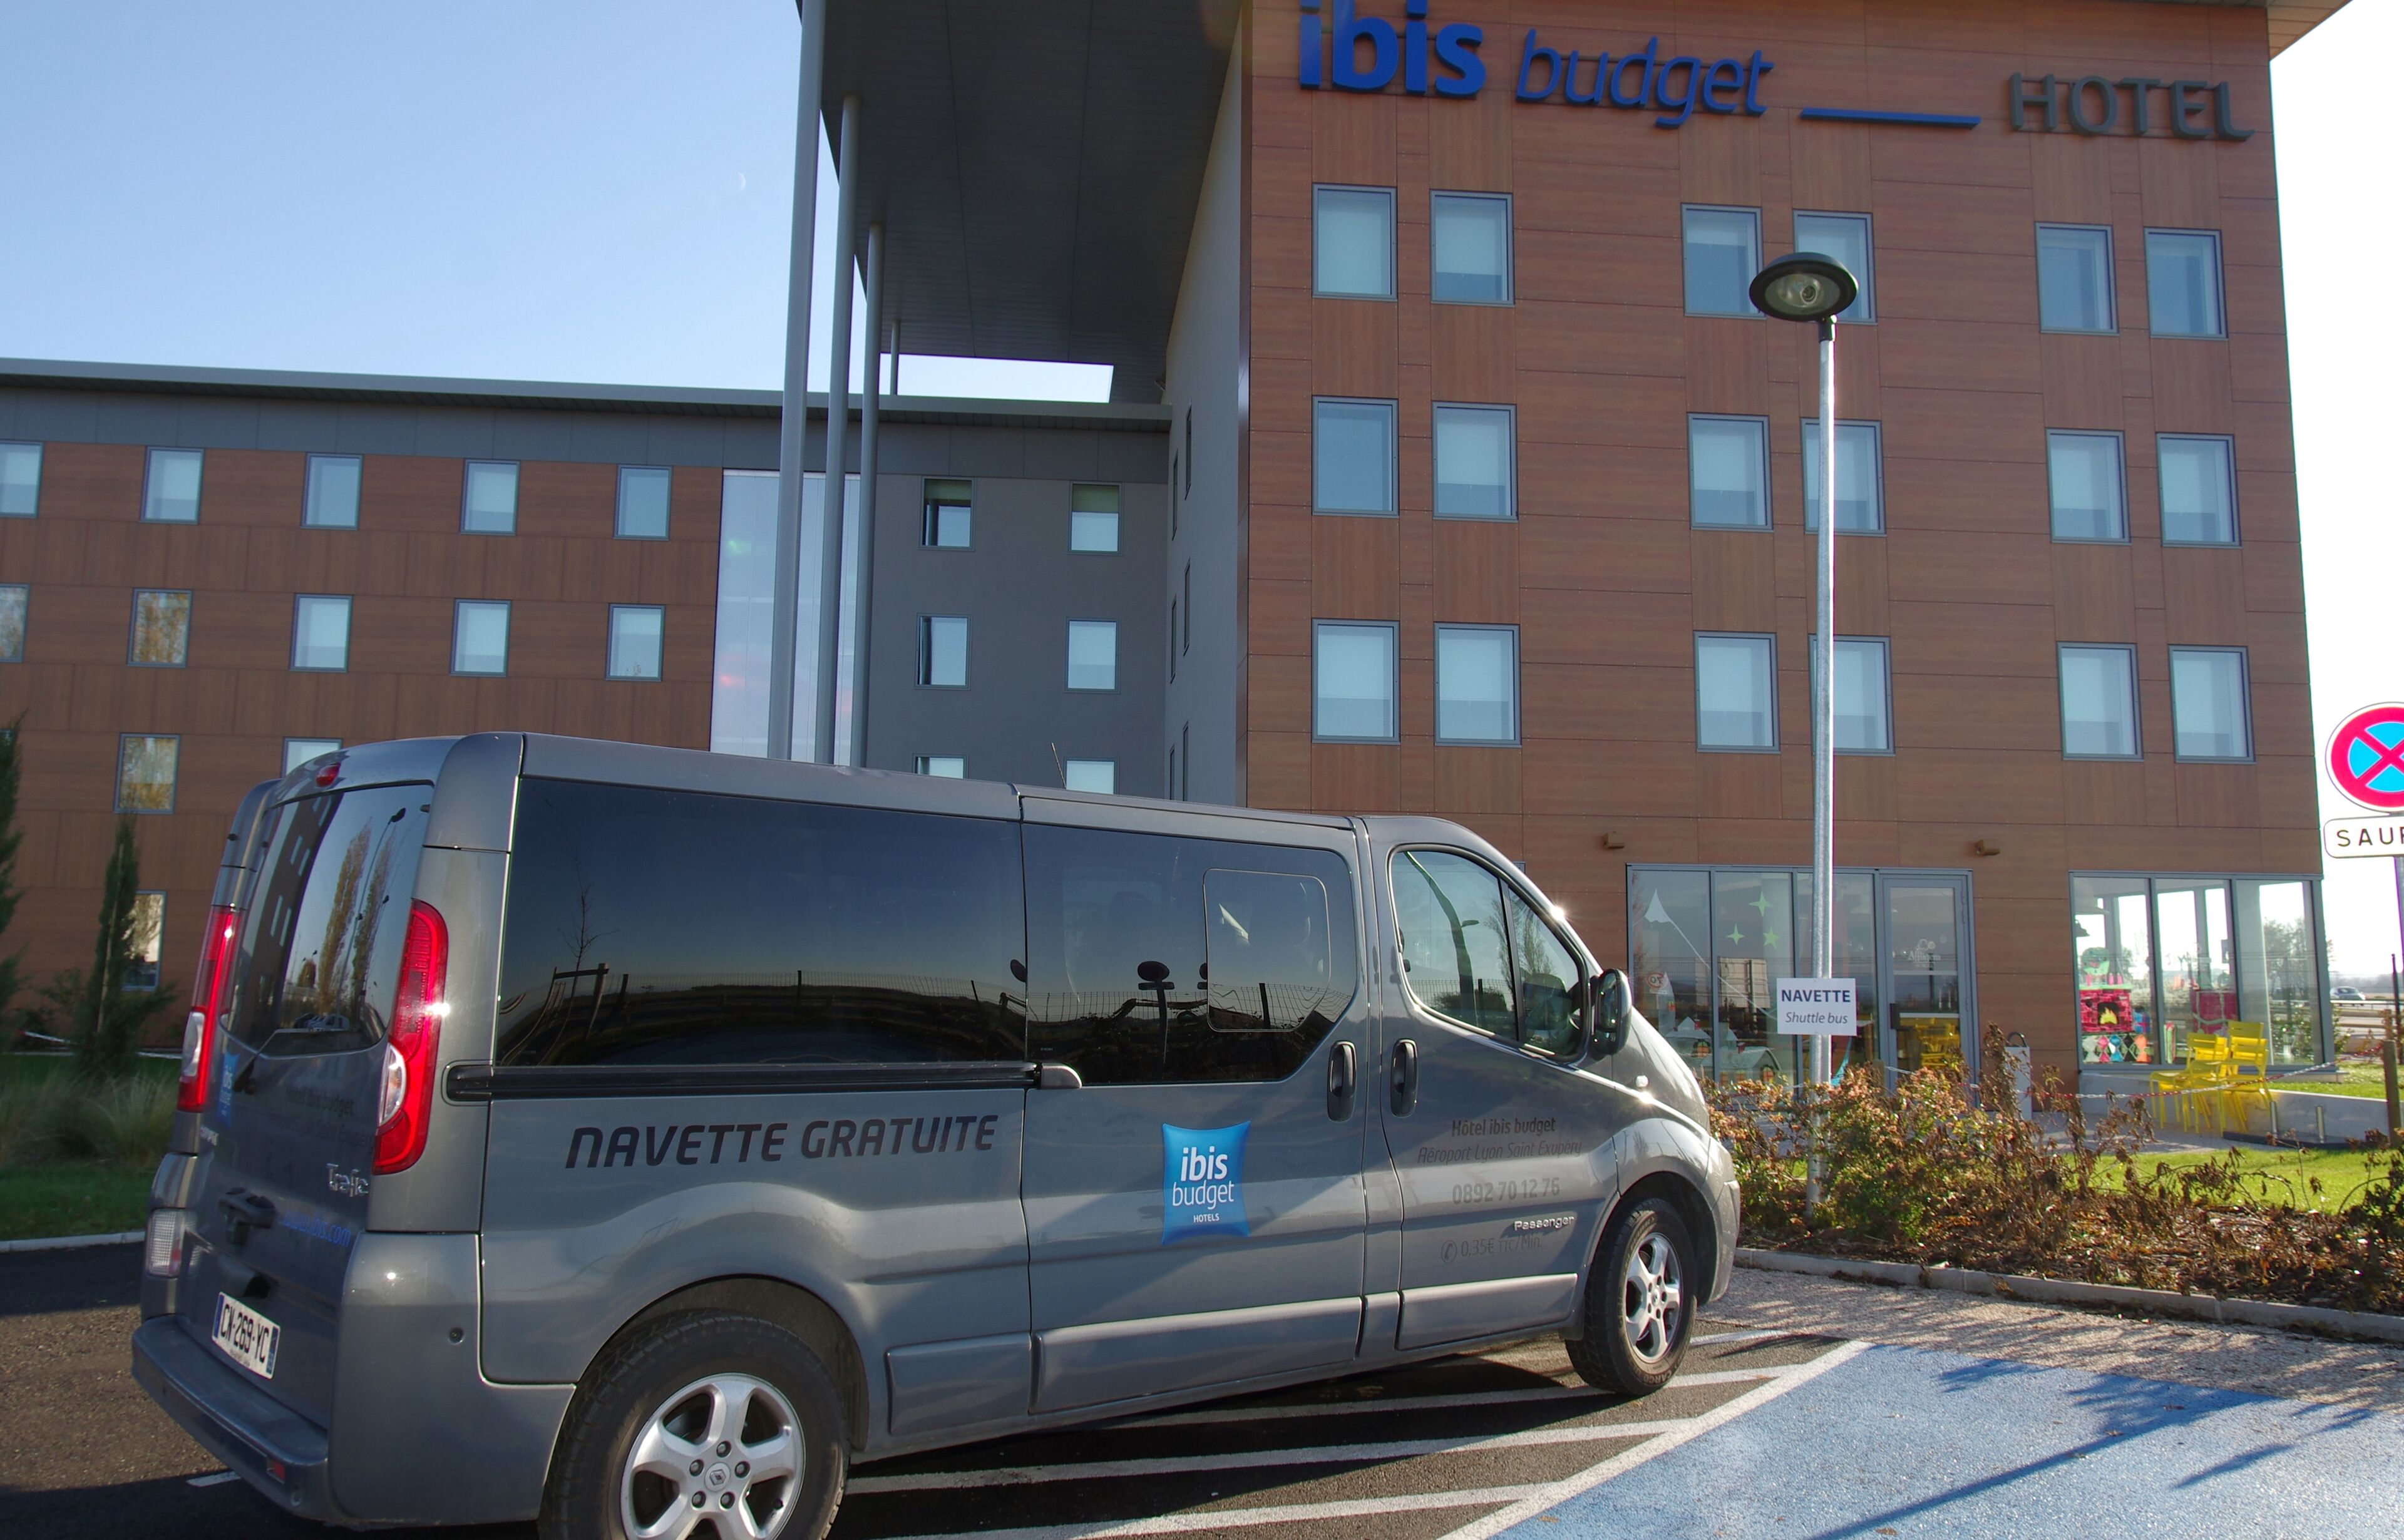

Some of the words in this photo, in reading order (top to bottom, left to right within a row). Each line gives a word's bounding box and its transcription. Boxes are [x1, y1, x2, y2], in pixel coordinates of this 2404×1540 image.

[1300, 0, 1487, 97] ibis
[1516, 29, 1774, 129] budget
[2008, 73, 2254, 141] HOTEL
[1781, 989, 1851, 1003] NAVETTE
[1785, 1012, 1826, 1024] Shuttle
[1827, 1012, 1848, 1024] bus
[1451, 1119, 1486, 1137] Hôtel
[1489, 1118, 1511, 1135] ibis
[1514, 1117, 1556, 1136] budget
[565, 1123, 788, 1169] NAVETTE
[801, 1115, 999, 1159] GRATUITE
[1417, 1147, 1472, 1166] Aéroport
[1474, 1144, 1503, 1164] Lyon
[1506, 1142, 1536, 1158] Saint
[1538, 1140, 1583, 1159] Exupéry
[1181, 1146, 1228, 1181] ibis
[1172, 1179, 1235, 1210] budget
[1452, 1183, 1494, 1204] 0892
[1499, 1180, 1518, 1201] 70
[1521, 1178, 1538, 1198] 12
[1542, 1177, 1561, 1197] 76
[1193, 1213, 1220, 1223] HOTELS
[1514, 1215, 1575, 1231] Passenger
